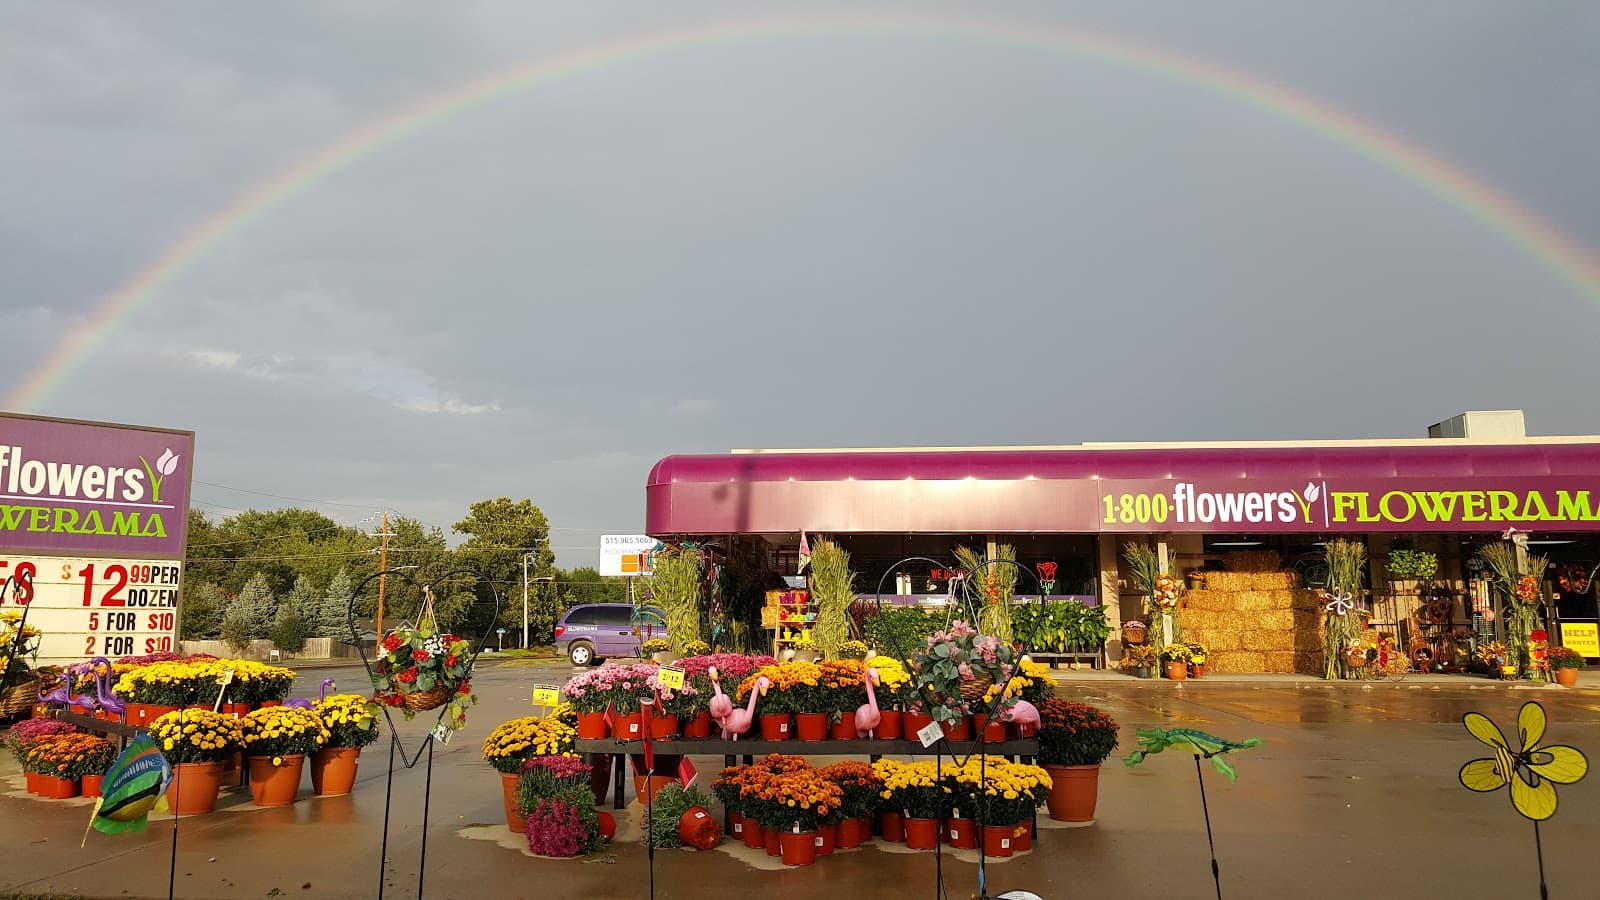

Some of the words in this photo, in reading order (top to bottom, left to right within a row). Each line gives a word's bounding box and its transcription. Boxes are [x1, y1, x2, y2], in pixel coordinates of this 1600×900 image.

[1331, 490, 1600, 522] FLOWERAM
[61, 564, 72, 580] $
[150, 565, 179, 585] PER
[128, 588, 178, 608] DOZEN
[89, 612, 99, 631] 5
[107, 612, 136, 631] FOR
[148, 612, 174, 631] $10
[85, 636, 96, 655] 2
[104, 636, 134, 656] FOR
[145, 635, 171, 655] $10
